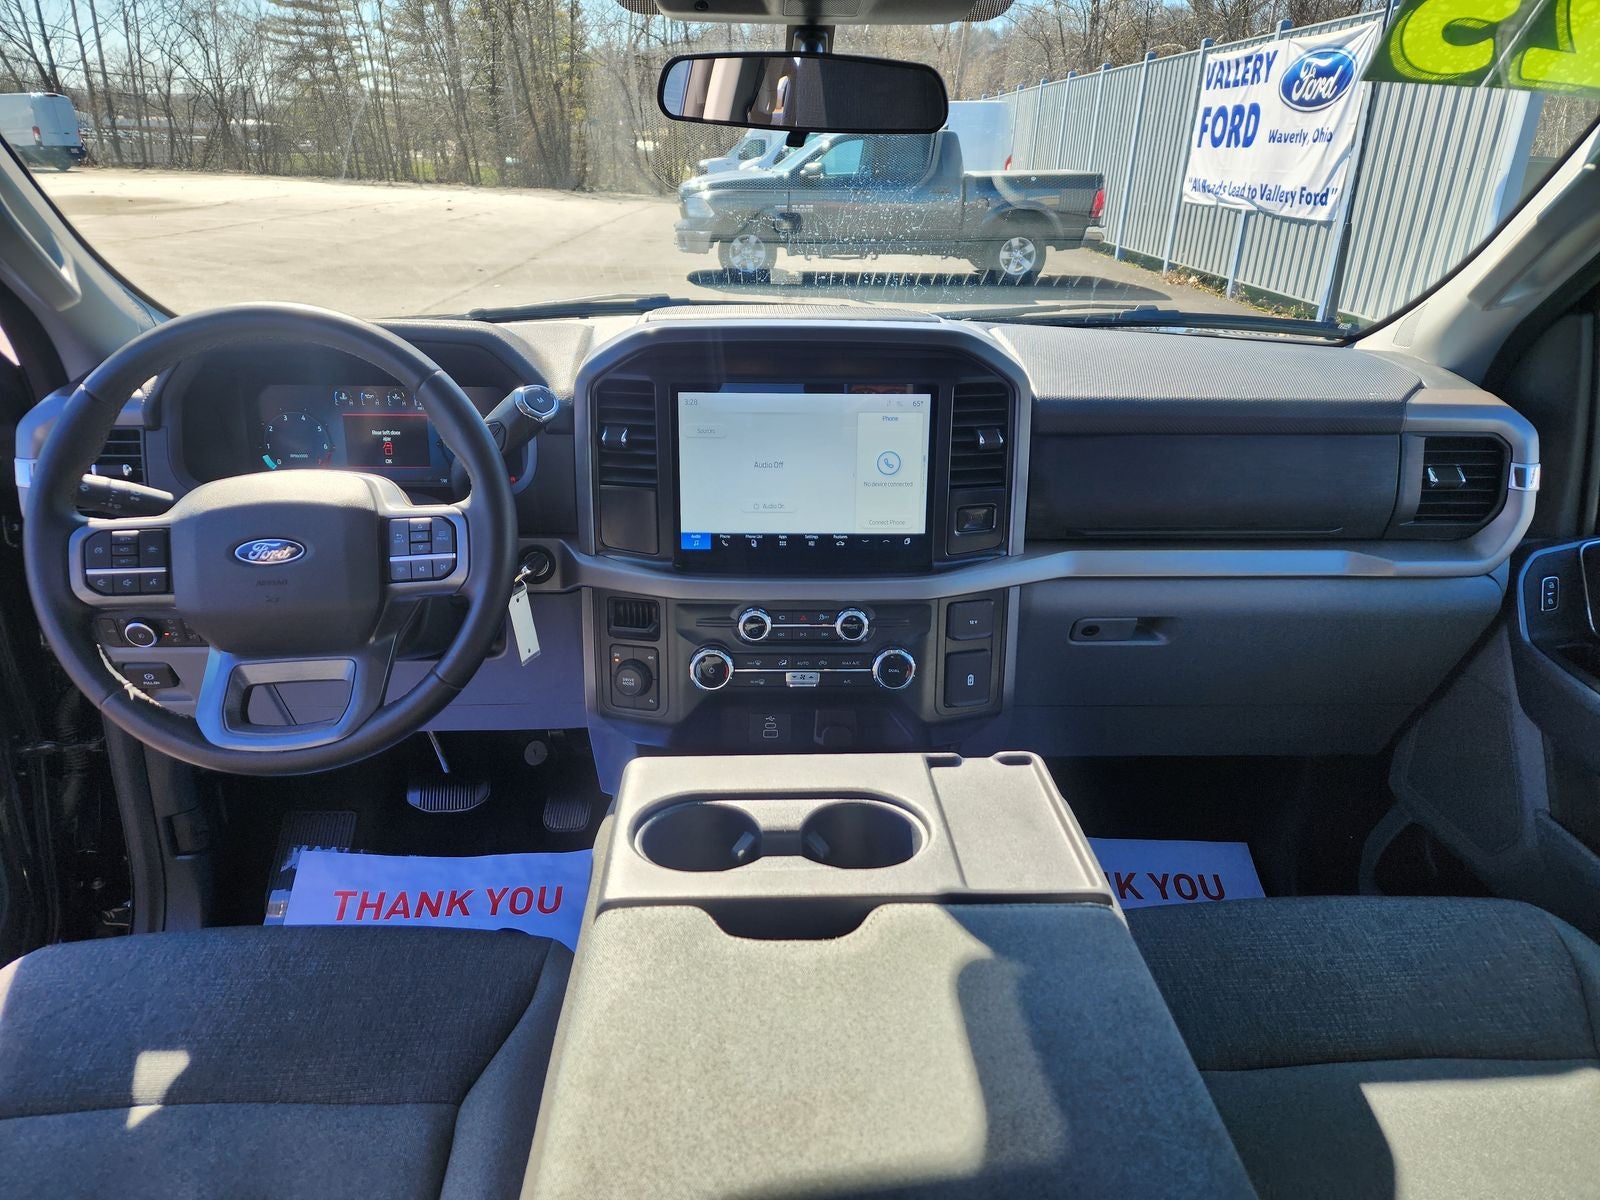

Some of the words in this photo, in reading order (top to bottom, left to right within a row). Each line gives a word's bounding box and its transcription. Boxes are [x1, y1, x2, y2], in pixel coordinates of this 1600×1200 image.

[1205, 49, 1279, 91] VALLERY
[1291, 57, 1344, 101] Ford
[1196, 102, 1261, 149] FORD
[1268, 128, 1310, 147] Waverly,
[1312, 127, 1333, 143] Ohio
[1228, 181, 1245, 198] Lead
[1247, 183, 1257, 200] to
[1260, 183, 1297, 208] Vallery
[1299, 186, 1338, 207] Ford"
[754, 461, 773, 469] Audio
[773, 461, 784, 469] Off
[247, 541, 298, 562] Ford
[1146, 872, 1226, 901] YOU
[333, 887, 476, 922] THANK
[485, 885, 564, 916] YOU
